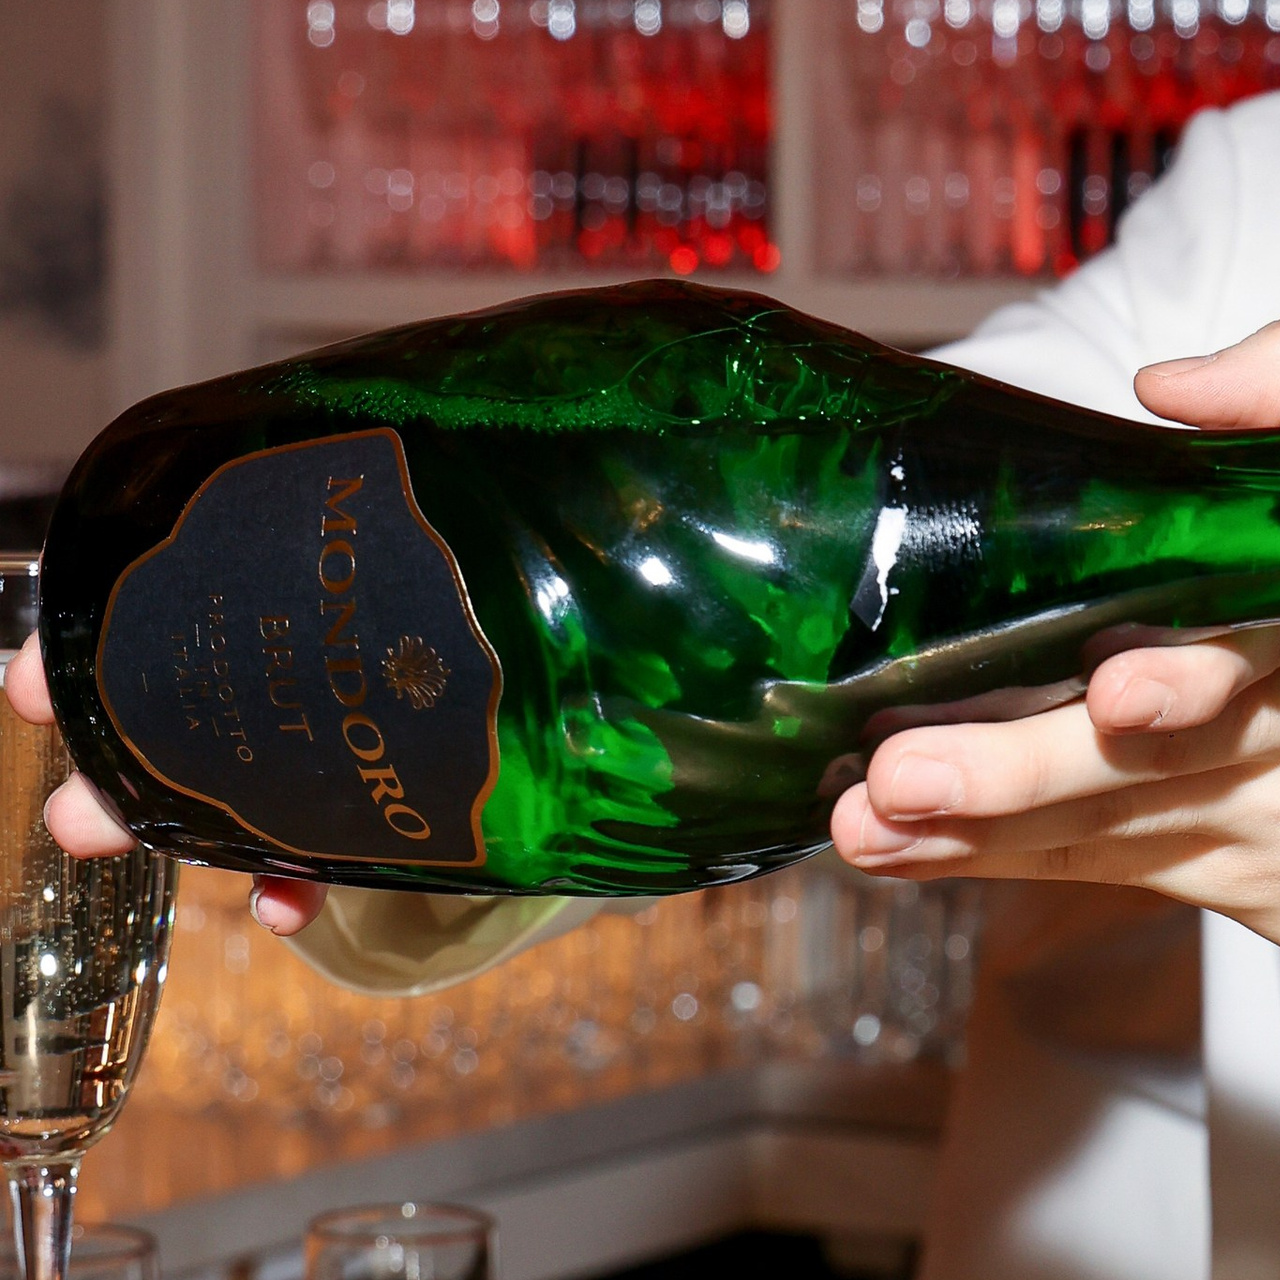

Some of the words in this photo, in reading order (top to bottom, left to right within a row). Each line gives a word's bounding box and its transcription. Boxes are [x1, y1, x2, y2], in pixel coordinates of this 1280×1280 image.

[170, 634, 201, 731] ITALIA
[208, 594, 254, 762] PRODOTTO
[259, 615, 314, 742] BRUT
[318, 474, 431, 840] MONDORO
